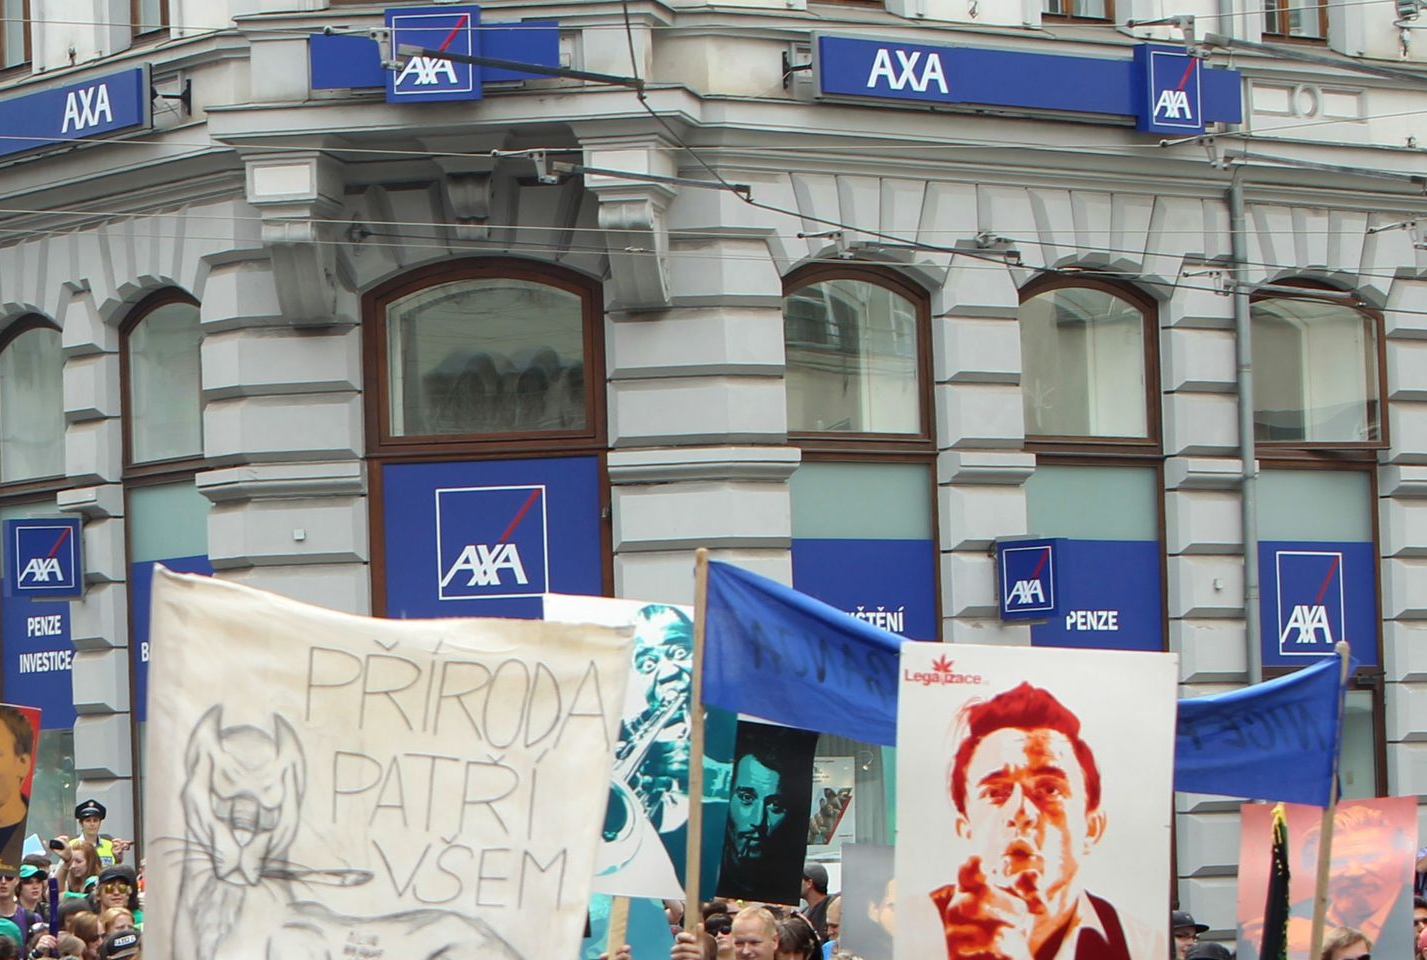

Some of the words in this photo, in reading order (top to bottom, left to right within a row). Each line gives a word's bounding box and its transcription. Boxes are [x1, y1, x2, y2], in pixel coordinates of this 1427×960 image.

[395, 56, 458, 85] AXA
[867, 48, 949, 94] AXA
[61, 83, 113, 134] AXA
[1153, 90, 1193, 119] AXA
[19, 557, 64, 582] AXA
[441, 543, 529, 586] AXA
[1007, 579, 1046, 605] AXA
[27, 615, 62, 638] PENZE
[1066, 611, 1119, 631] PENZE
[1280, 605, 1333, 644] AXA
[19, 650, 72, 674] INVESTICE
[305, 639, 612, 753] PŘÍRODA
[331, 748, 548, 841] PATŘÍ
[371, 834, 568, 911] VŠEM
